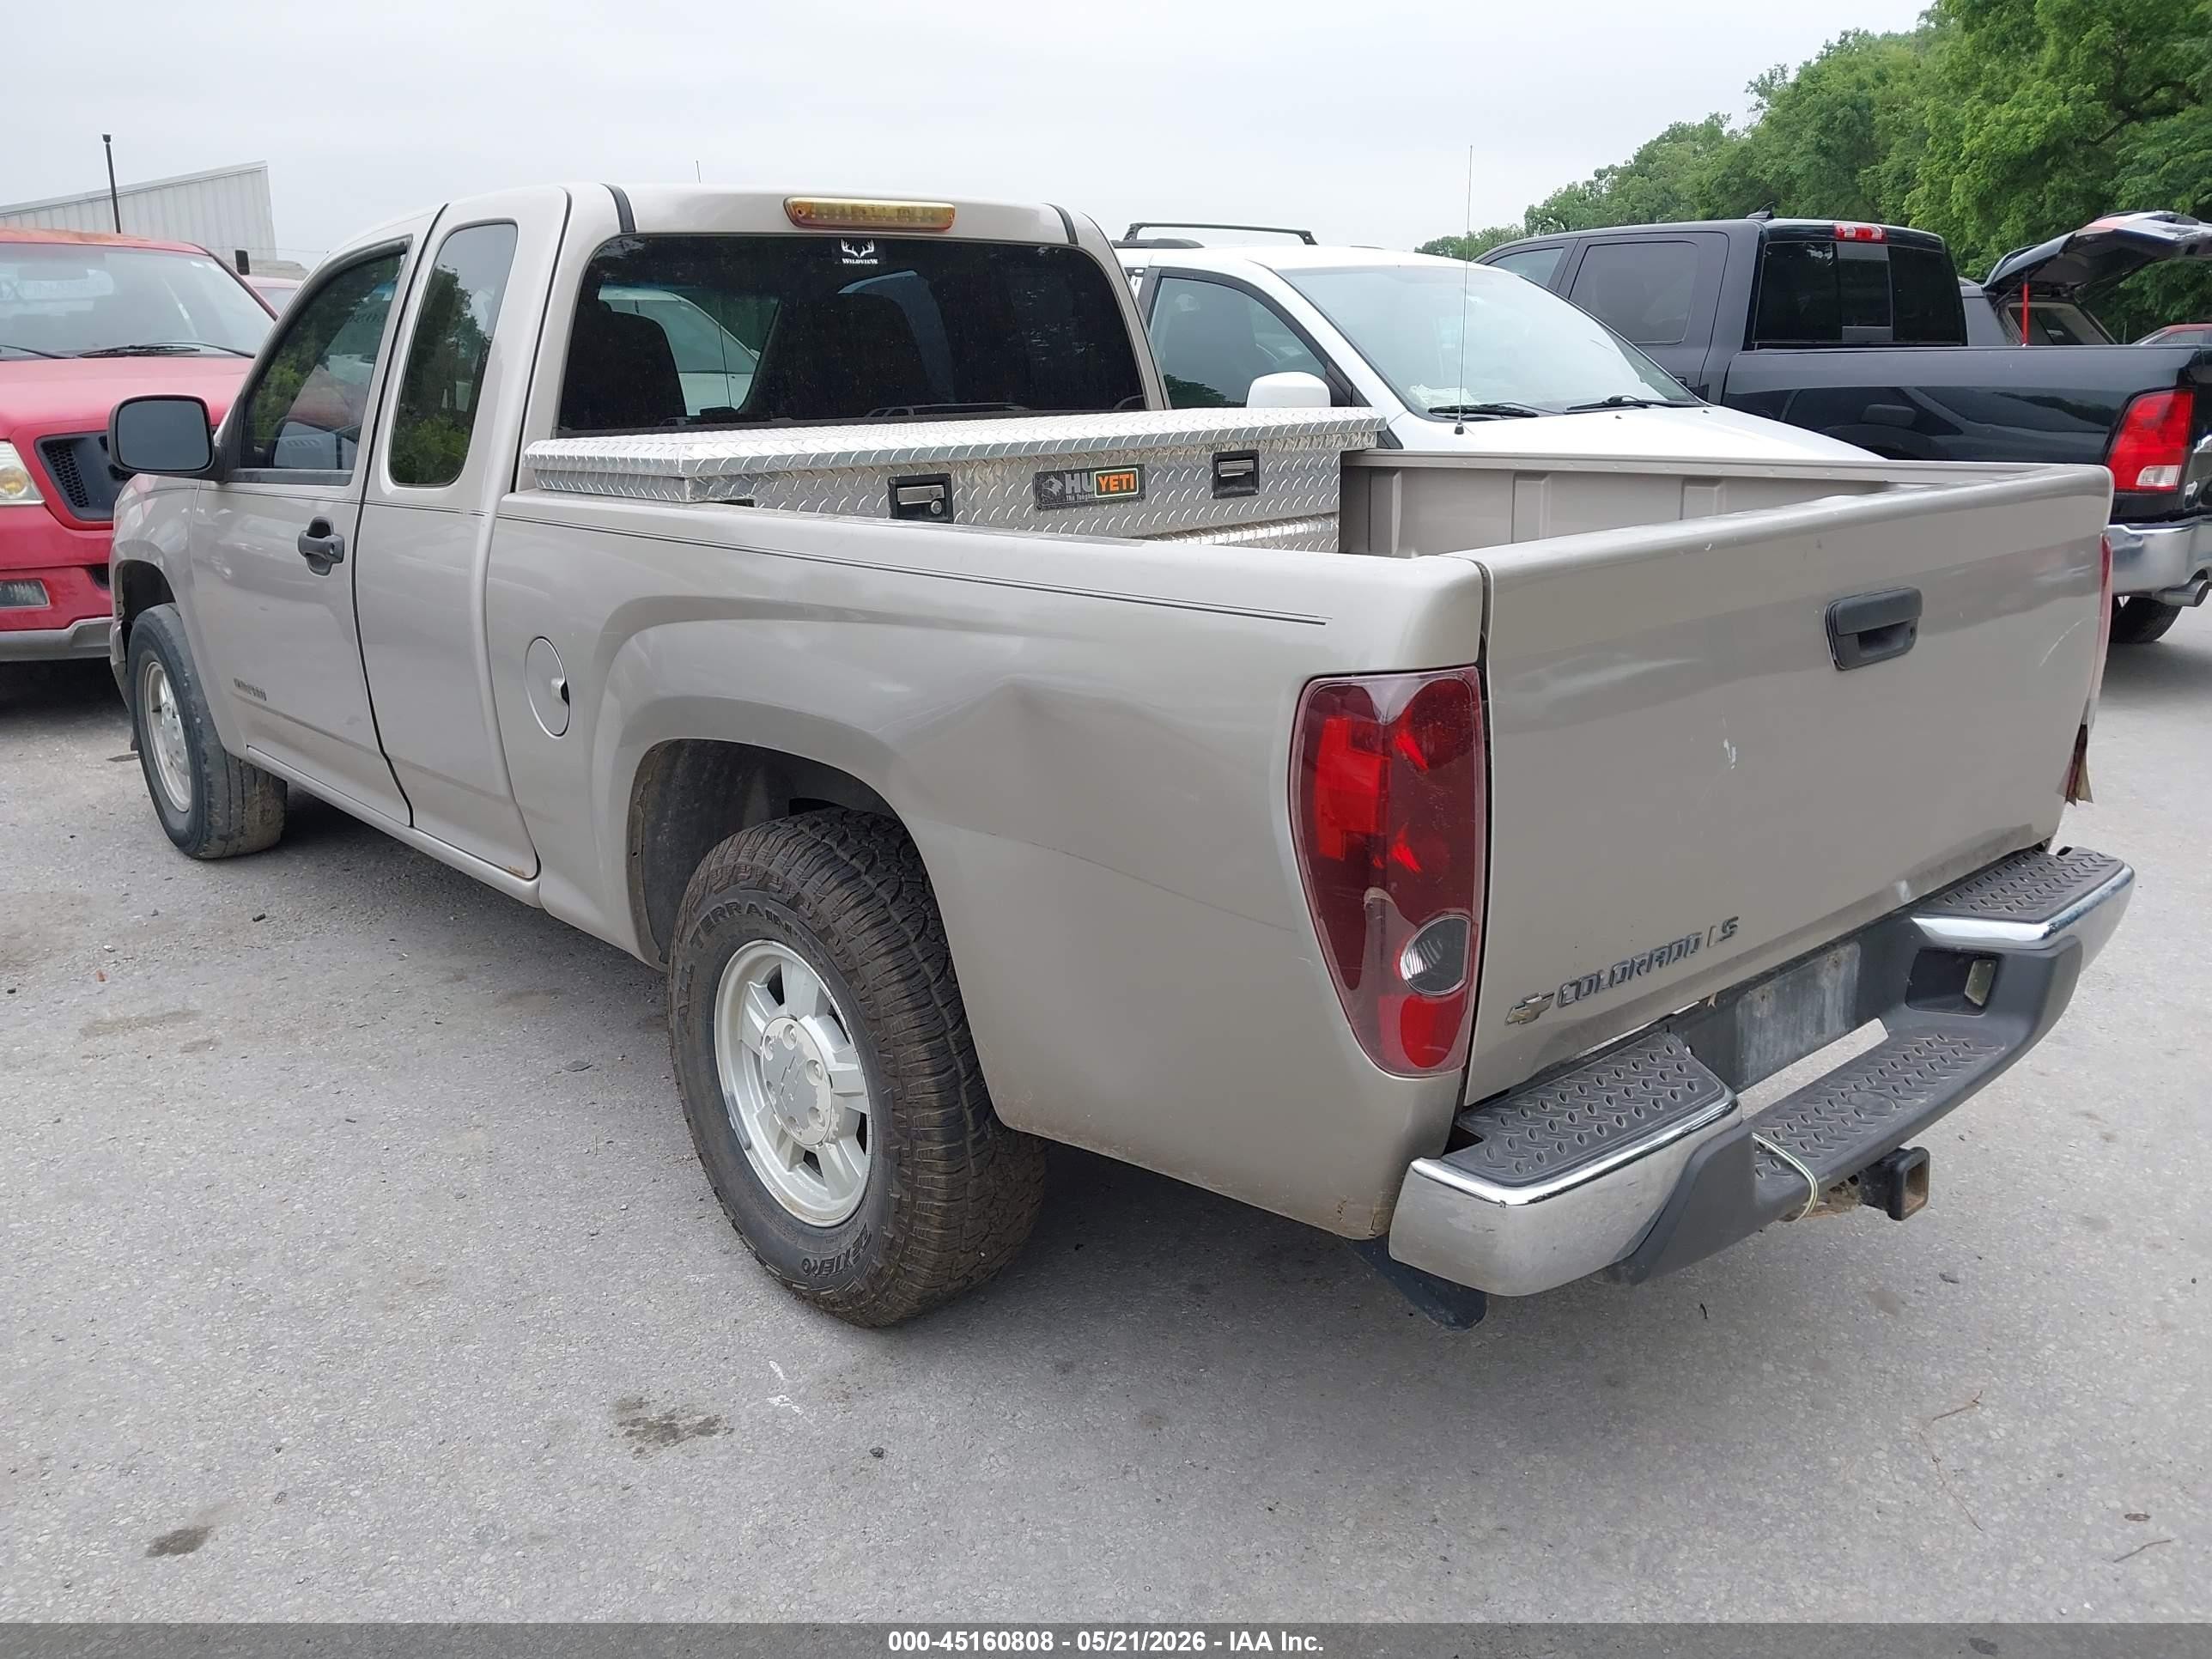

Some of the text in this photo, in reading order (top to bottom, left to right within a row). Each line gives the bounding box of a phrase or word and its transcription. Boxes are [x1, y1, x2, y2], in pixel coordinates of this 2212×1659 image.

[1097, 473, 1134, 492] YETI
[1557, 915, 1740, 1007] COLORADO LS
[801, 1221, 872, 1278] DEXTERO
